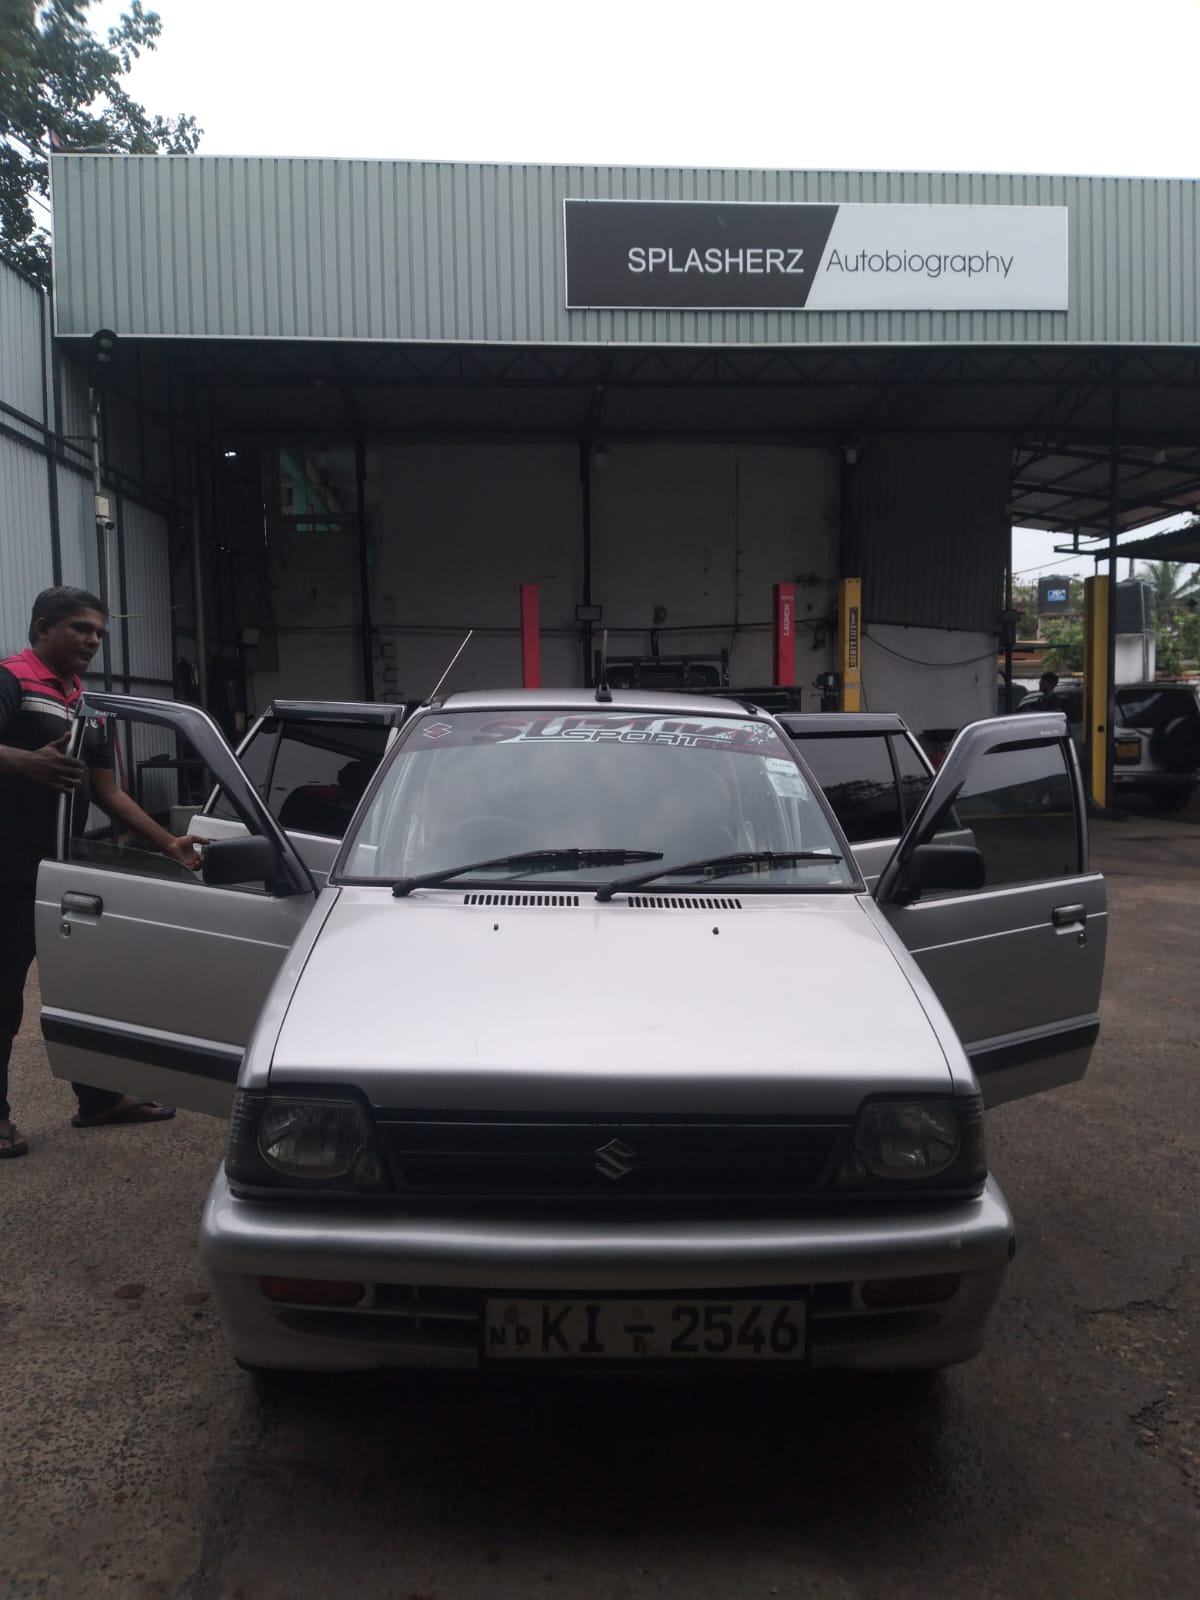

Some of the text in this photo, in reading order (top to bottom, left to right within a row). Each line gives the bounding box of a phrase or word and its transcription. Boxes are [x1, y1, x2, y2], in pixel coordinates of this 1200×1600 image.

[627, 247, 1014, 278] SPLASHERZ Autobiography
[783, 603, 791, 637] LAUNCH
[555, 728, 699, 747] SPORT
[541, 1304, 605, 1353] KI
[670, 1304, 800, 1354] 2546
